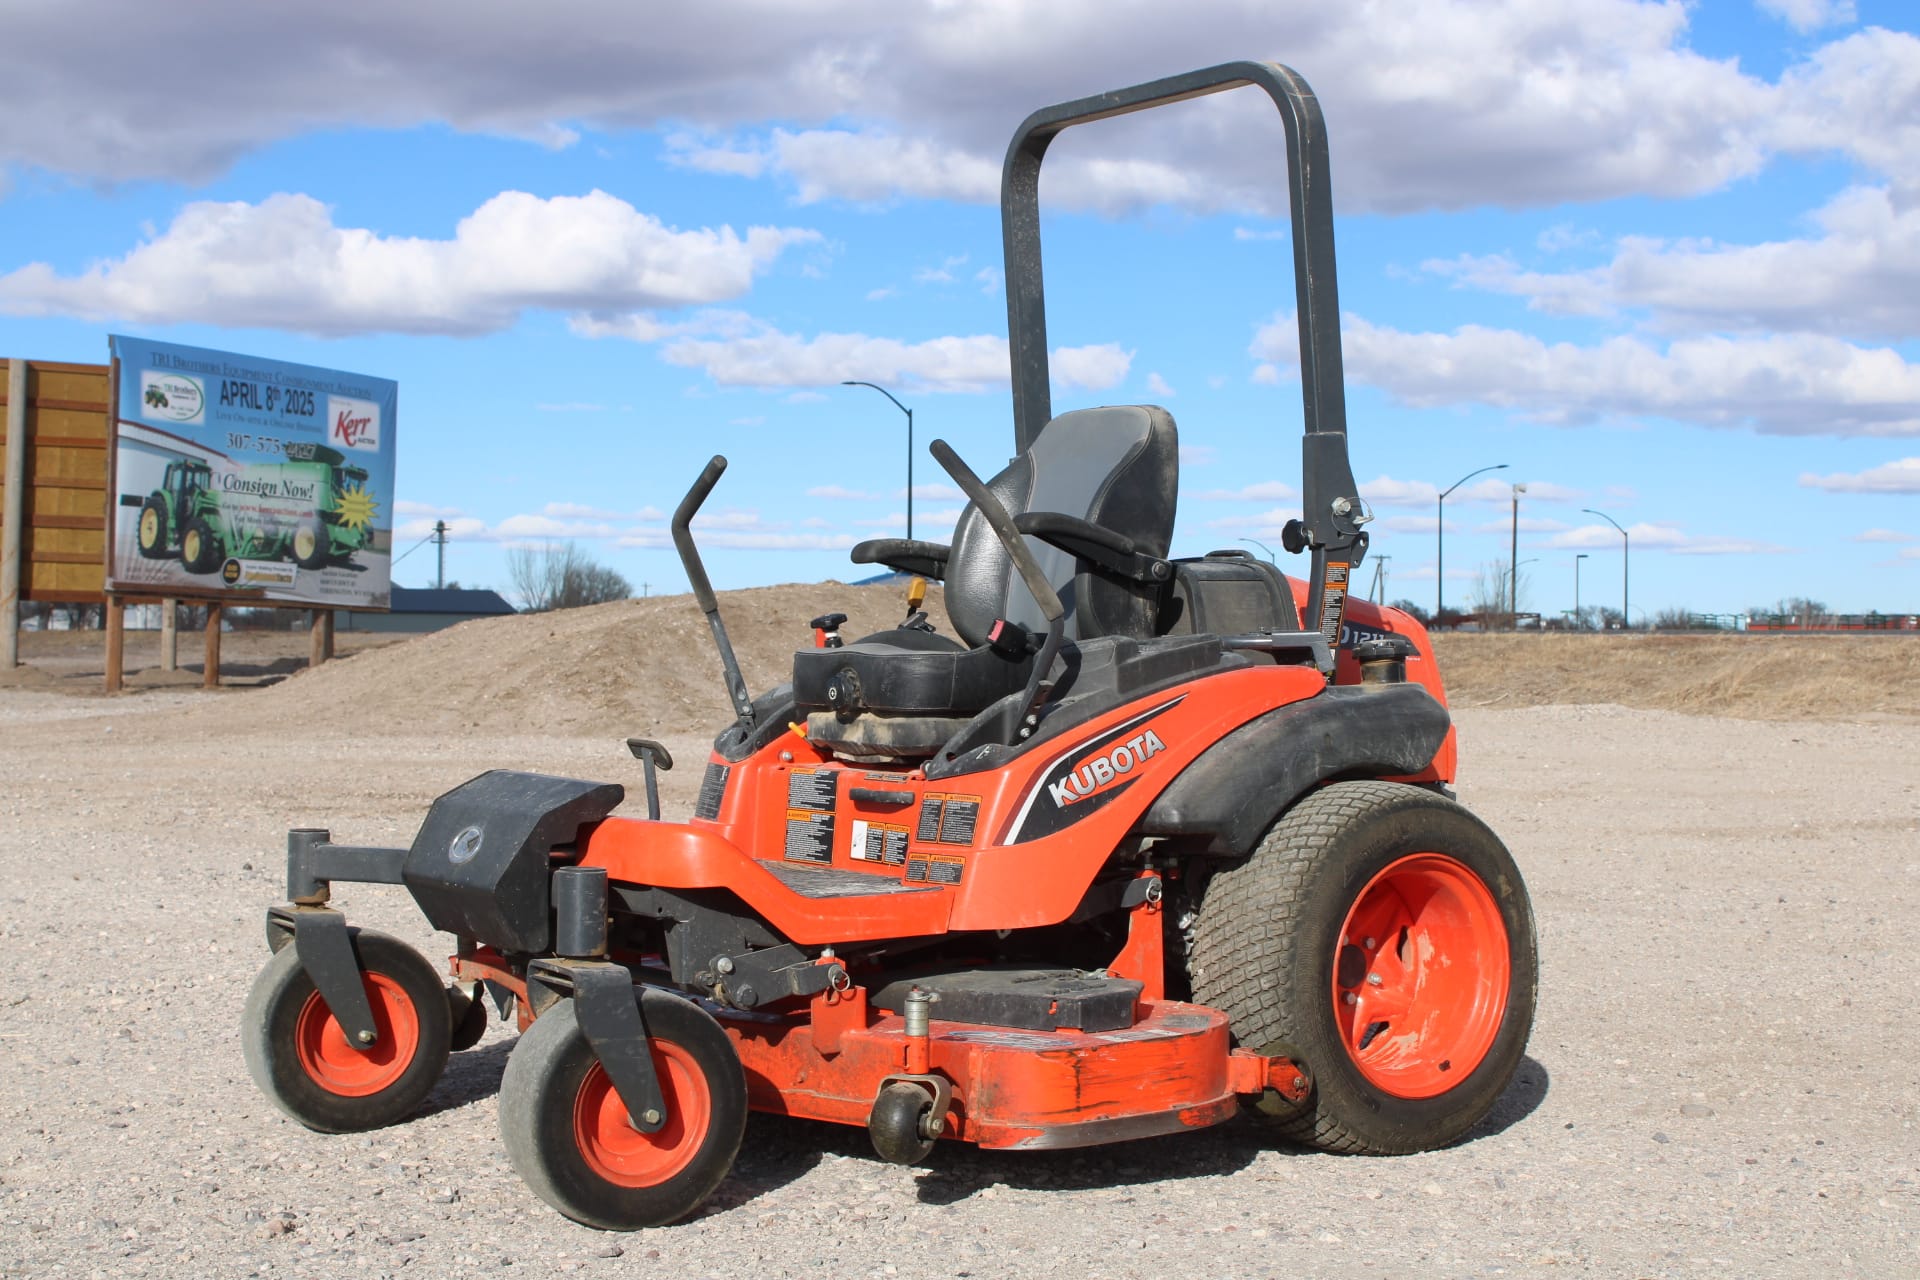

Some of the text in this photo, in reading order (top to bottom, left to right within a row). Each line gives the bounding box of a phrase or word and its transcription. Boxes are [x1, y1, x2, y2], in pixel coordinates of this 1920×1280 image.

[220, 380, 262, 410] APRIL
[334, 410, 371, 447] Kerr
[223, 473, 315, 499] Consign Now!
[1048, 729, 1167, 808] KUBOTA
